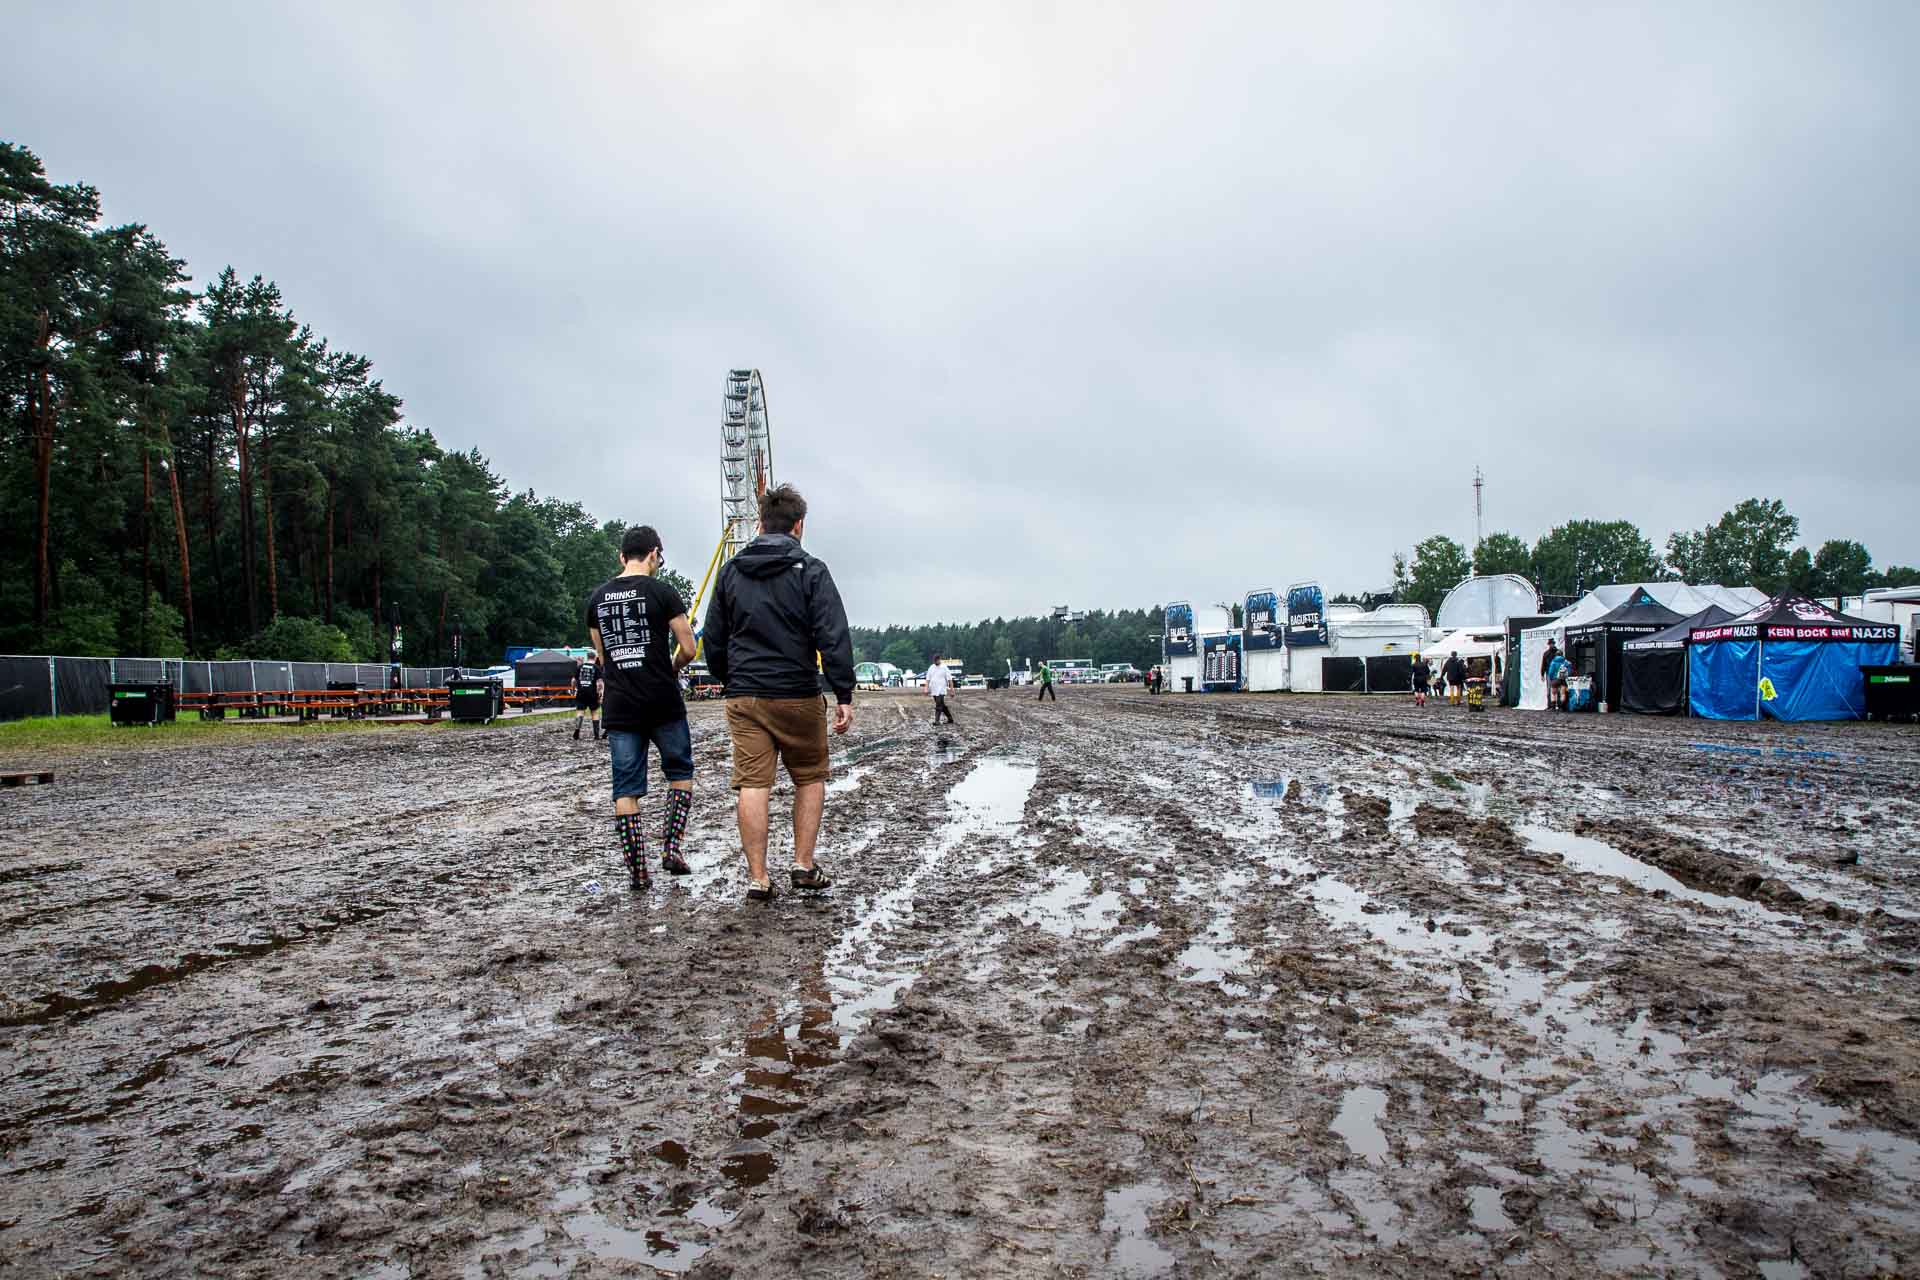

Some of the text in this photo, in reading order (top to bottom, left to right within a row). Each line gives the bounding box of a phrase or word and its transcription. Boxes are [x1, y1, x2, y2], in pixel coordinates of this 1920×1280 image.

[605, 590, 637, 601] DRINKS
[1290, 613, 1319, 625] BAGUETTE
[1692, 631, 1705, 640] KEIN
[1705, 628, 1721, 639] BOCK
[1733, 626, 1757, 637] NAZIS
[1767, 628, 1897, 638] KEIN BOCK auf NAZIS
